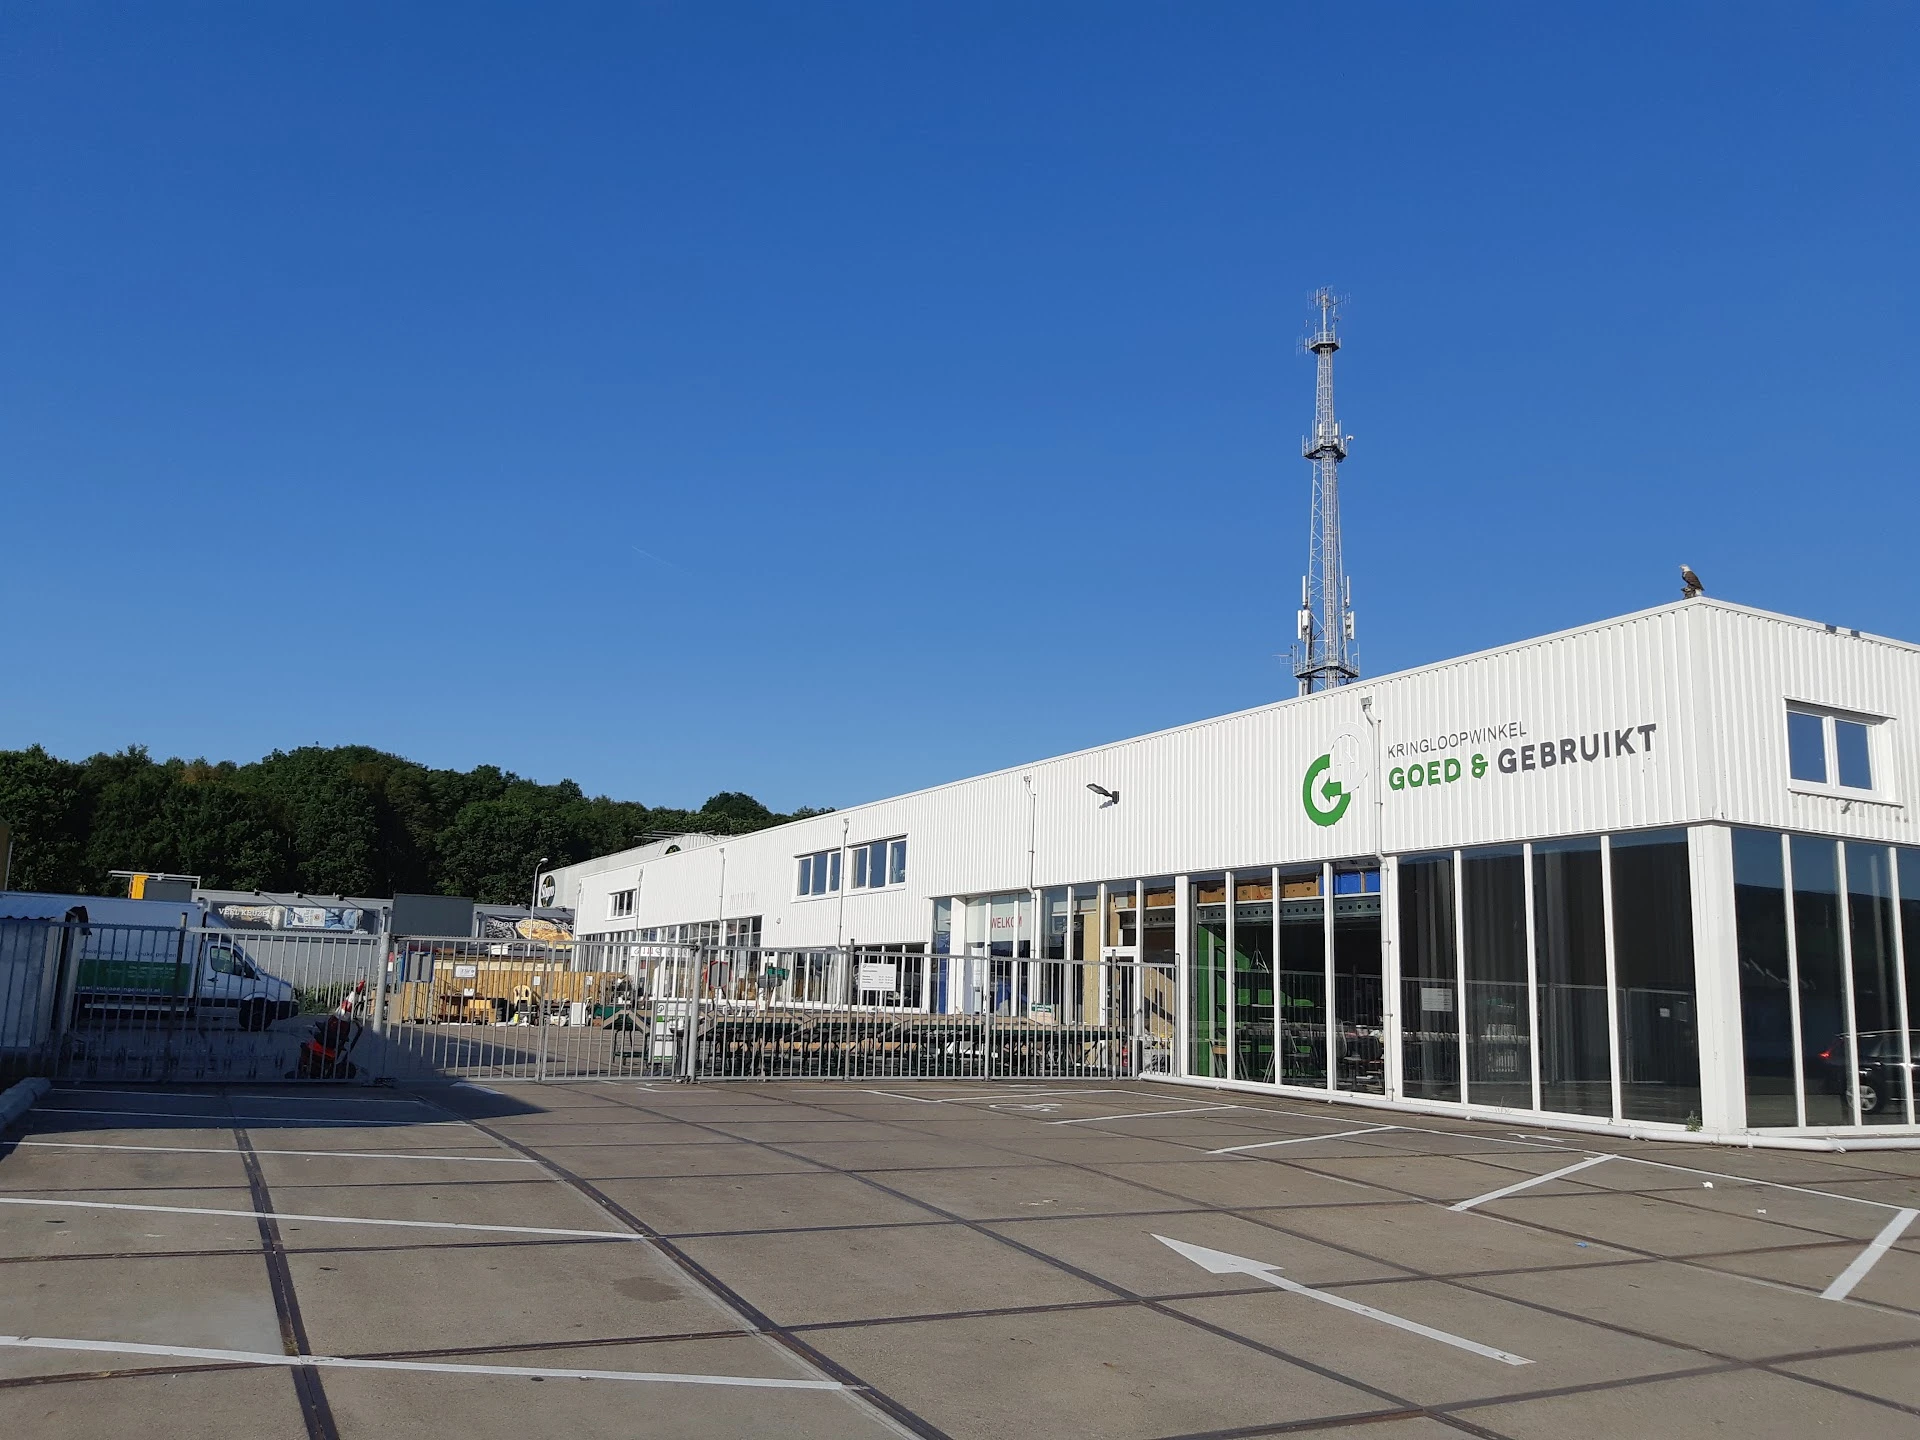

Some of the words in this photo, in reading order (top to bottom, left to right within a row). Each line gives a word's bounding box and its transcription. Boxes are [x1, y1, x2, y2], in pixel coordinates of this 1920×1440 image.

[1387, 721, 1527, 759] KRINGLOOPWINKEL
[1388, 758, 1461, 791] GOED
[1471, 753, 1488, 779] &
[1498, 723, 1657, 774] GEBRUIKT
[218, 907, 240, 916] VEEL
[241, 908, 268, 917] KEUZE
[493, 920, 514, 928] VOOR
